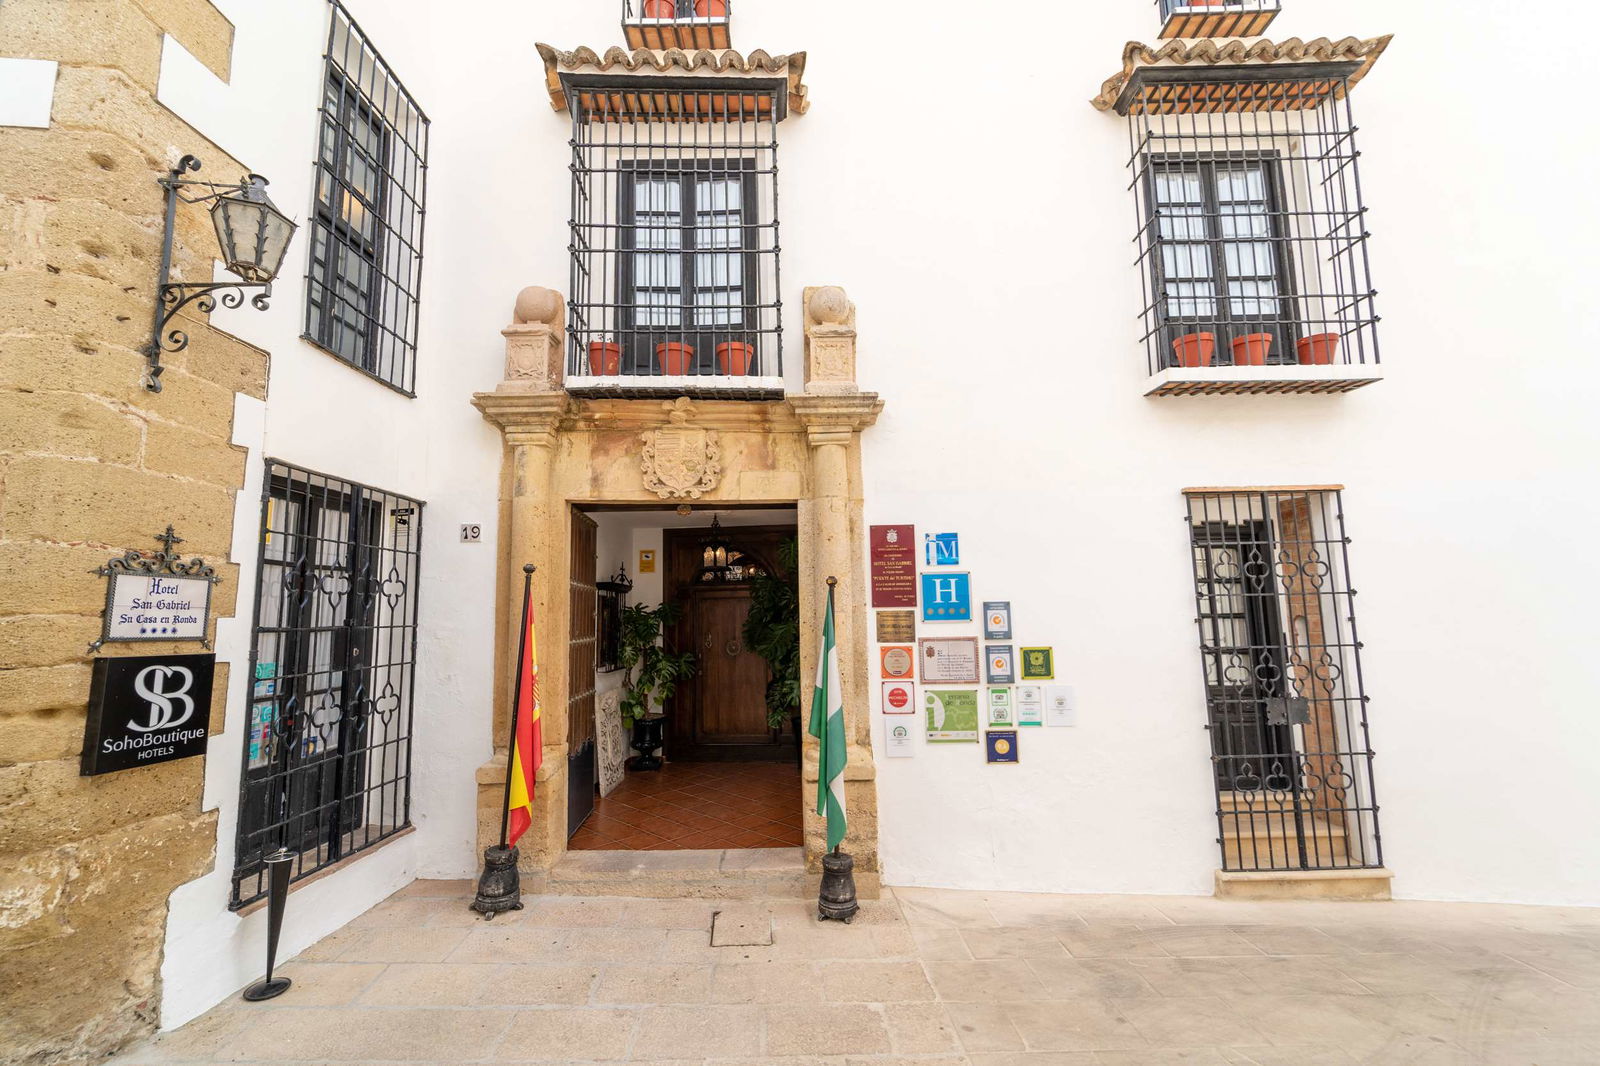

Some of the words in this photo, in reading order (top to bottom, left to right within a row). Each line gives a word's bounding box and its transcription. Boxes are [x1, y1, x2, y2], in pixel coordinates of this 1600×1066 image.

[462, 526, 481, 540] 19
[149, 578, 179, 596] Hotel
[932, 578, 960, 604] H
[130, 598, 153, 611] San
[156, 599, 191, 611] Gabriel
[136, 614, 158, 624] Casa
[172, 614, 197, 625] Ronda
[102, 728, 205, 754] SohoBoutique
[137, 746, 175, 761] HOTELS
